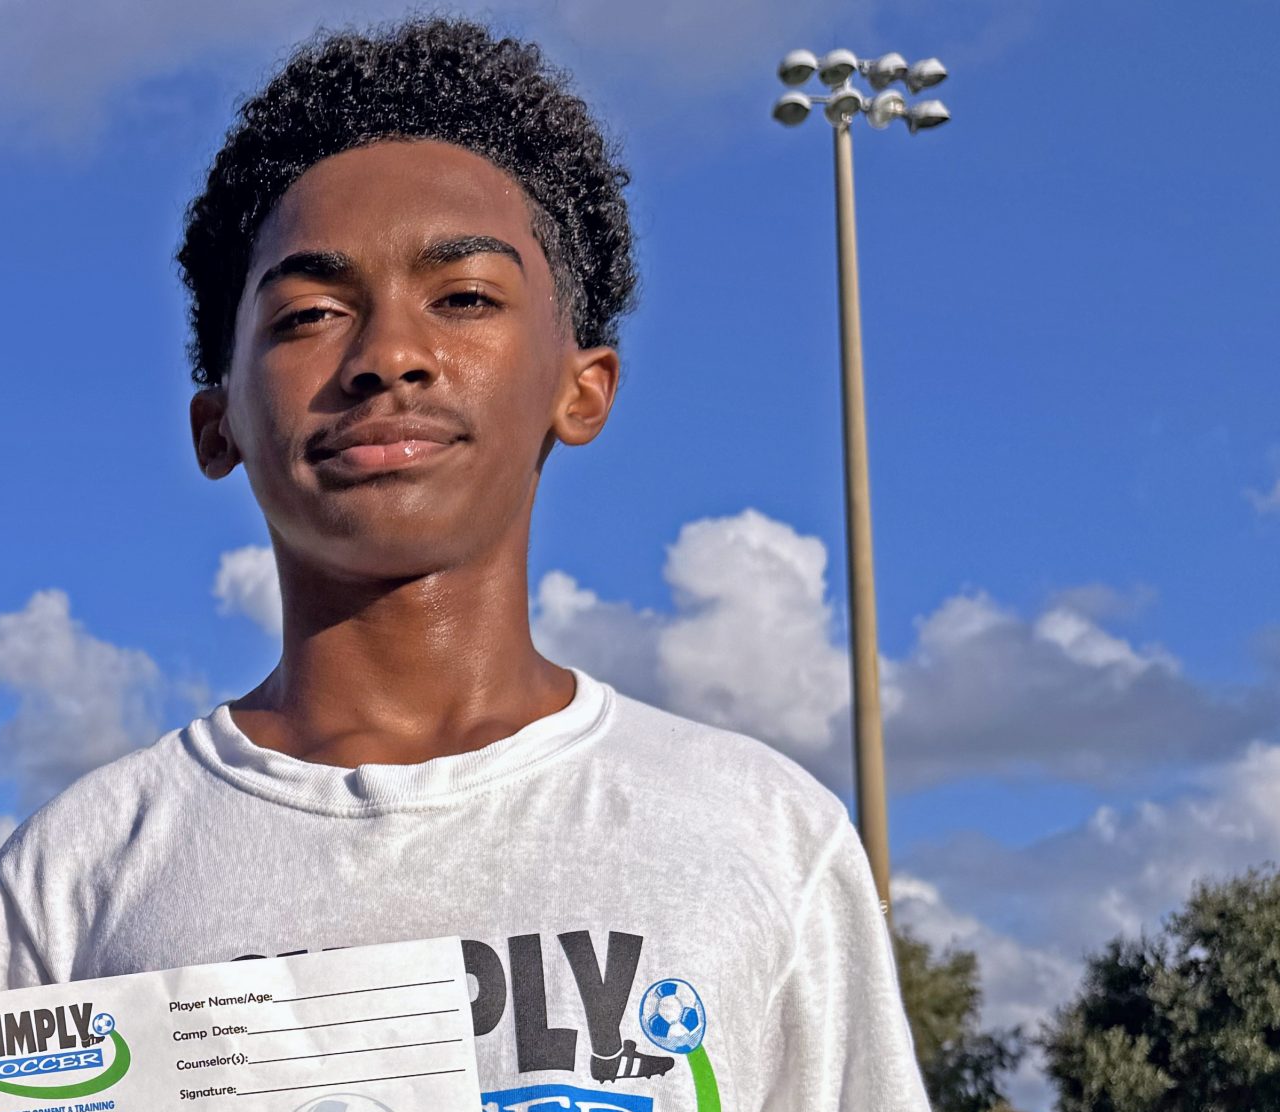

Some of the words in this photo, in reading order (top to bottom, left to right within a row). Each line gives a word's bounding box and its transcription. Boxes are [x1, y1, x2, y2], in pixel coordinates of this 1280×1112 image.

[169, 1001, 205, 1012] Player
[209, 993, 272, 1007] Name/Age:
[461, 930, 645, 1083] PLY
[173, 1031, 207, 1041] Camp
[212, 1026, 249, 1036] Dates:
[176, 1053, 249, 1070] Counselor(s):
[180, 1087, 238, 1100] Signature:
[74, 1100, 115, 1112] TRAINING
